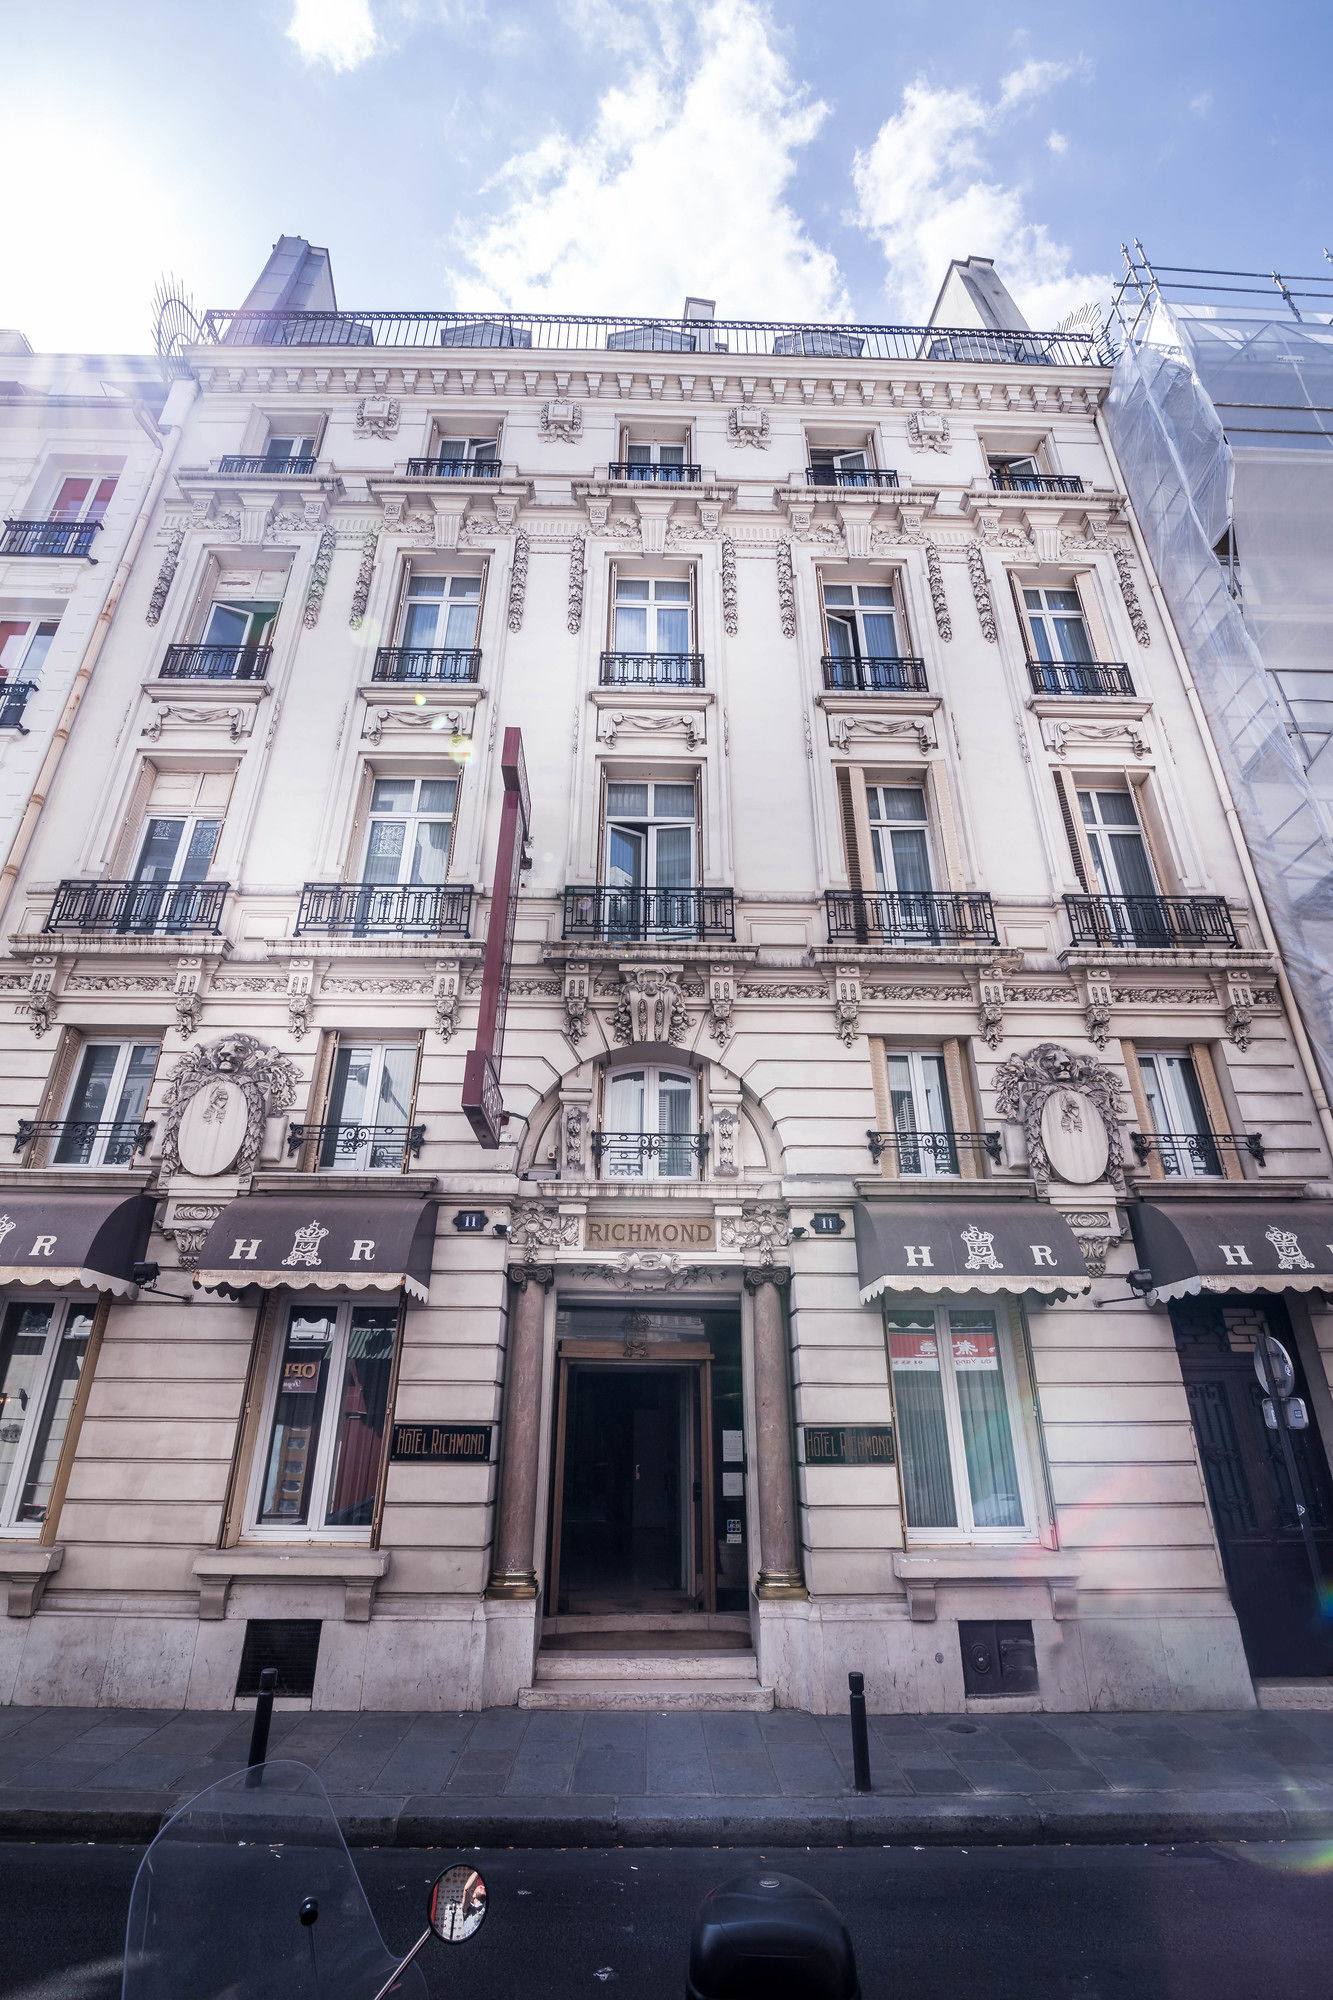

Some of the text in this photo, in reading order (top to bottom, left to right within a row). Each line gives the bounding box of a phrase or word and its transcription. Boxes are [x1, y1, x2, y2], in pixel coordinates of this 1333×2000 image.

[464, 1215, 476, 1227] 11
[822, 1217, 833, 1229] 11
[588, 1223, 713, 1243] RICHMOND
[28, 1235, 58, 1256] R
[229, 1238, 376, 1261] H R
[903, 1245, 1058, 1267] H R
[1218, 1244, 1254, 1266] H
[430, 1428, 485, 1455] RICHMOND
[840, 1431, 893, 1457] RICHMOND
